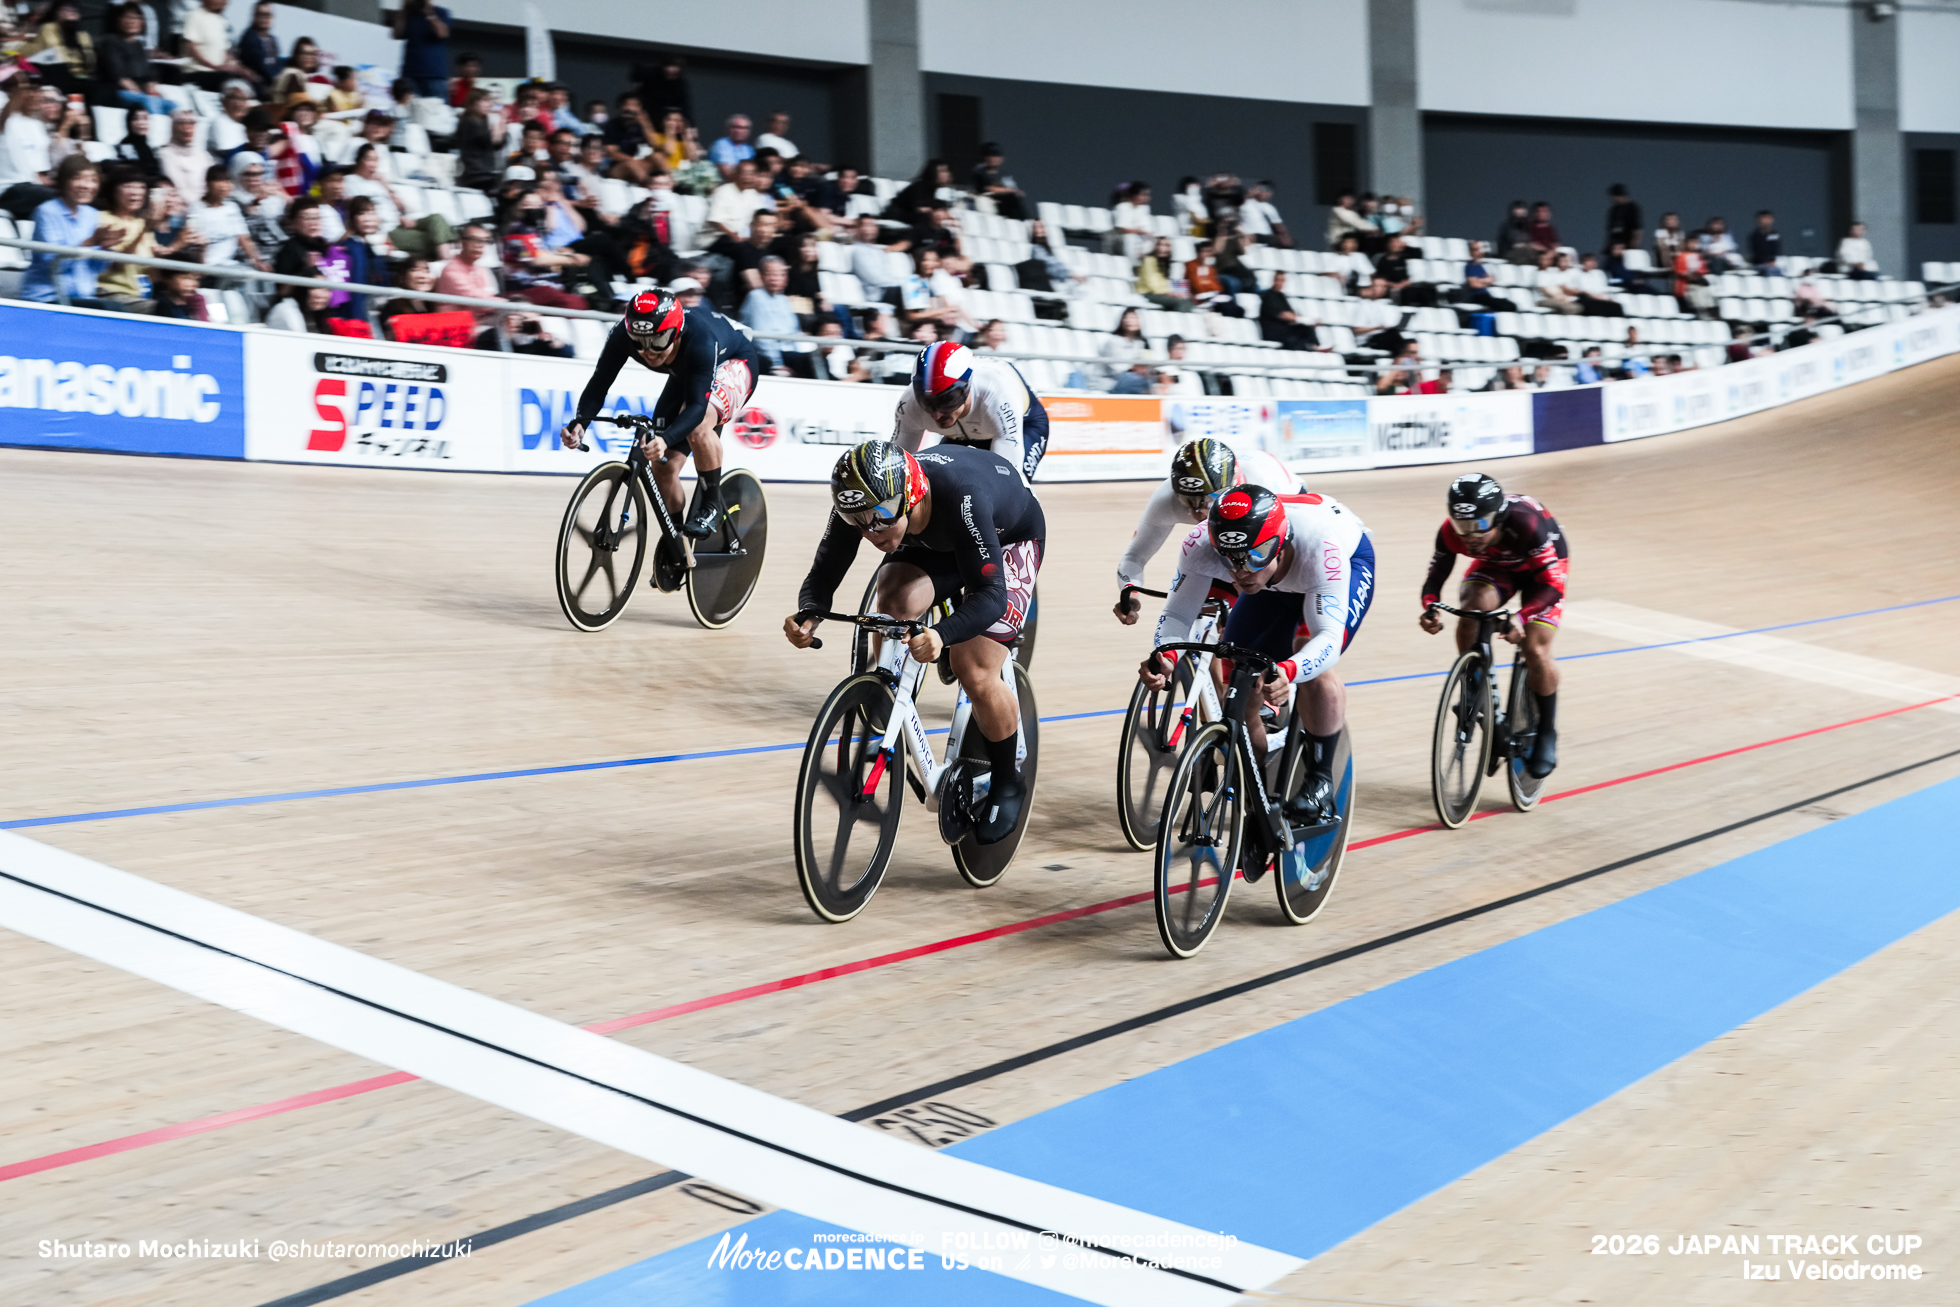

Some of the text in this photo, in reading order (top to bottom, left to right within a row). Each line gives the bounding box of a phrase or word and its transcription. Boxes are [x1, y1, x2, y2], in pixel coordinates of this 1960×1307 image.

[0, 354, 221, 423] anasonic
[307, 378, 446, 452] SPEED
[872, 440, 884, 480] Kabu
[645, 464, 677, 538] BRIDGESTONE
[963, 495, 975, 528] Rakuten
[1348, 566, 1373, 627] JAPAN
[873, 1101, 998, 1148] 250
